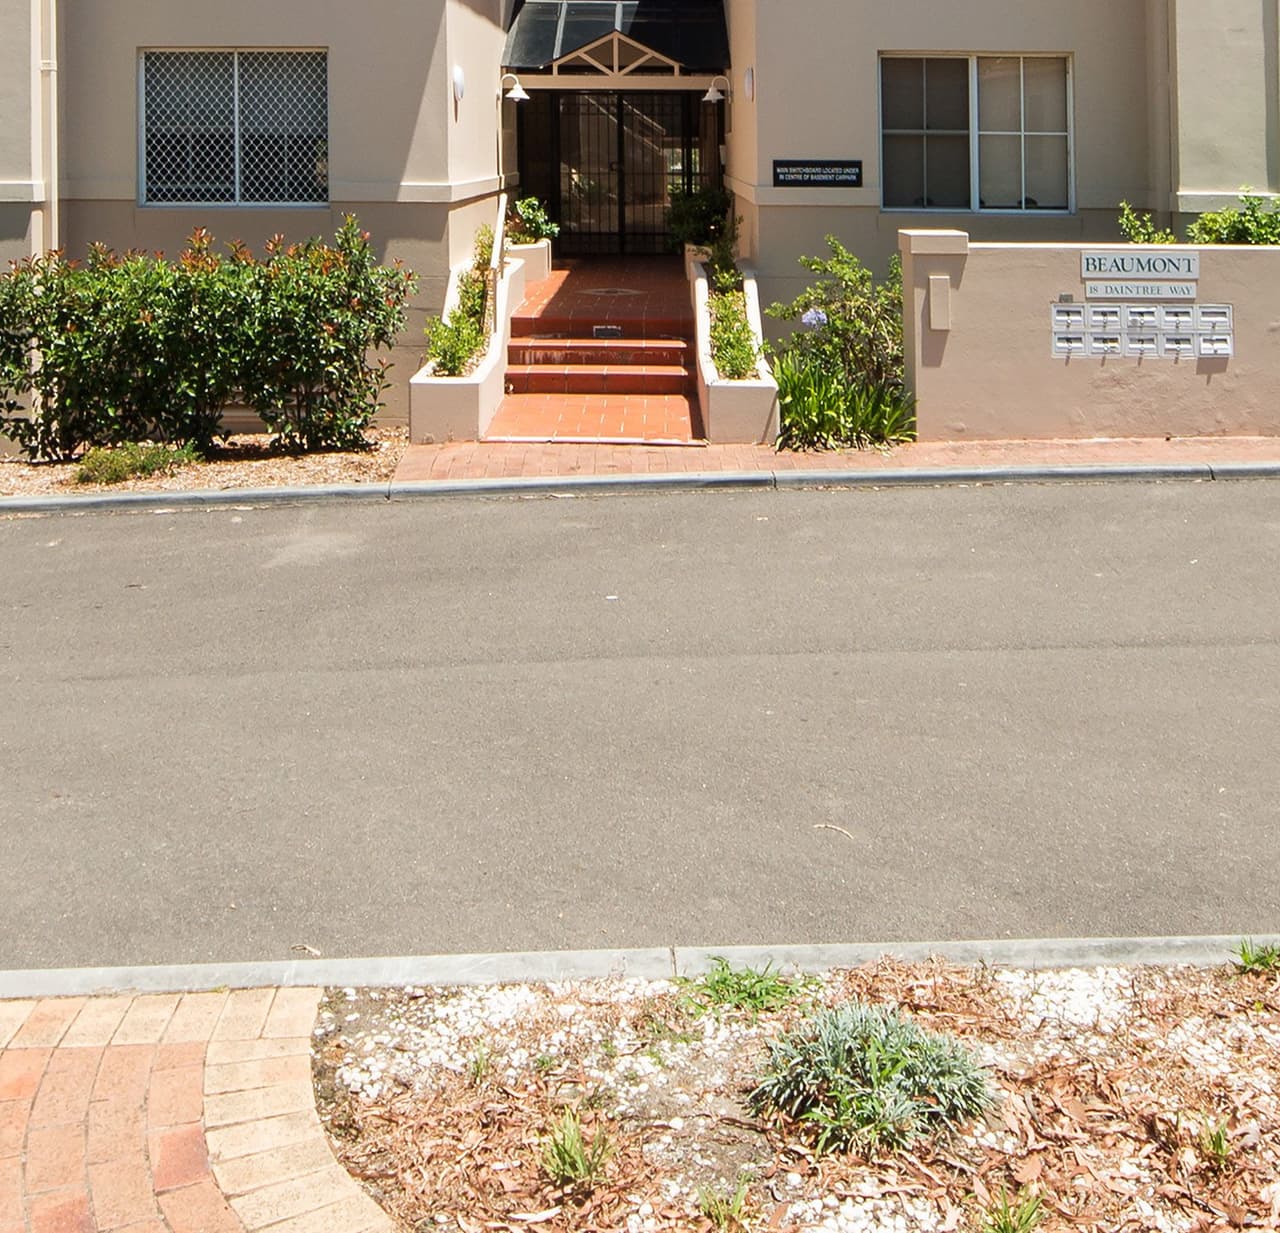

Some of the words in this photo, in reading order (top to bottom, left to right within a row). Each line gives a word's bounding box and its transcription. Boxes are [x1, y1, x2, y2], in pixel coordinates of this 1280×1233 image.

[1085, 256, 1196, 273] BEAUMONT
[1089, 285, 1098, 294] 18
[1104, 285, 1163, 295] DAINTREE
[1169, 285, 1193, 295] WAY
